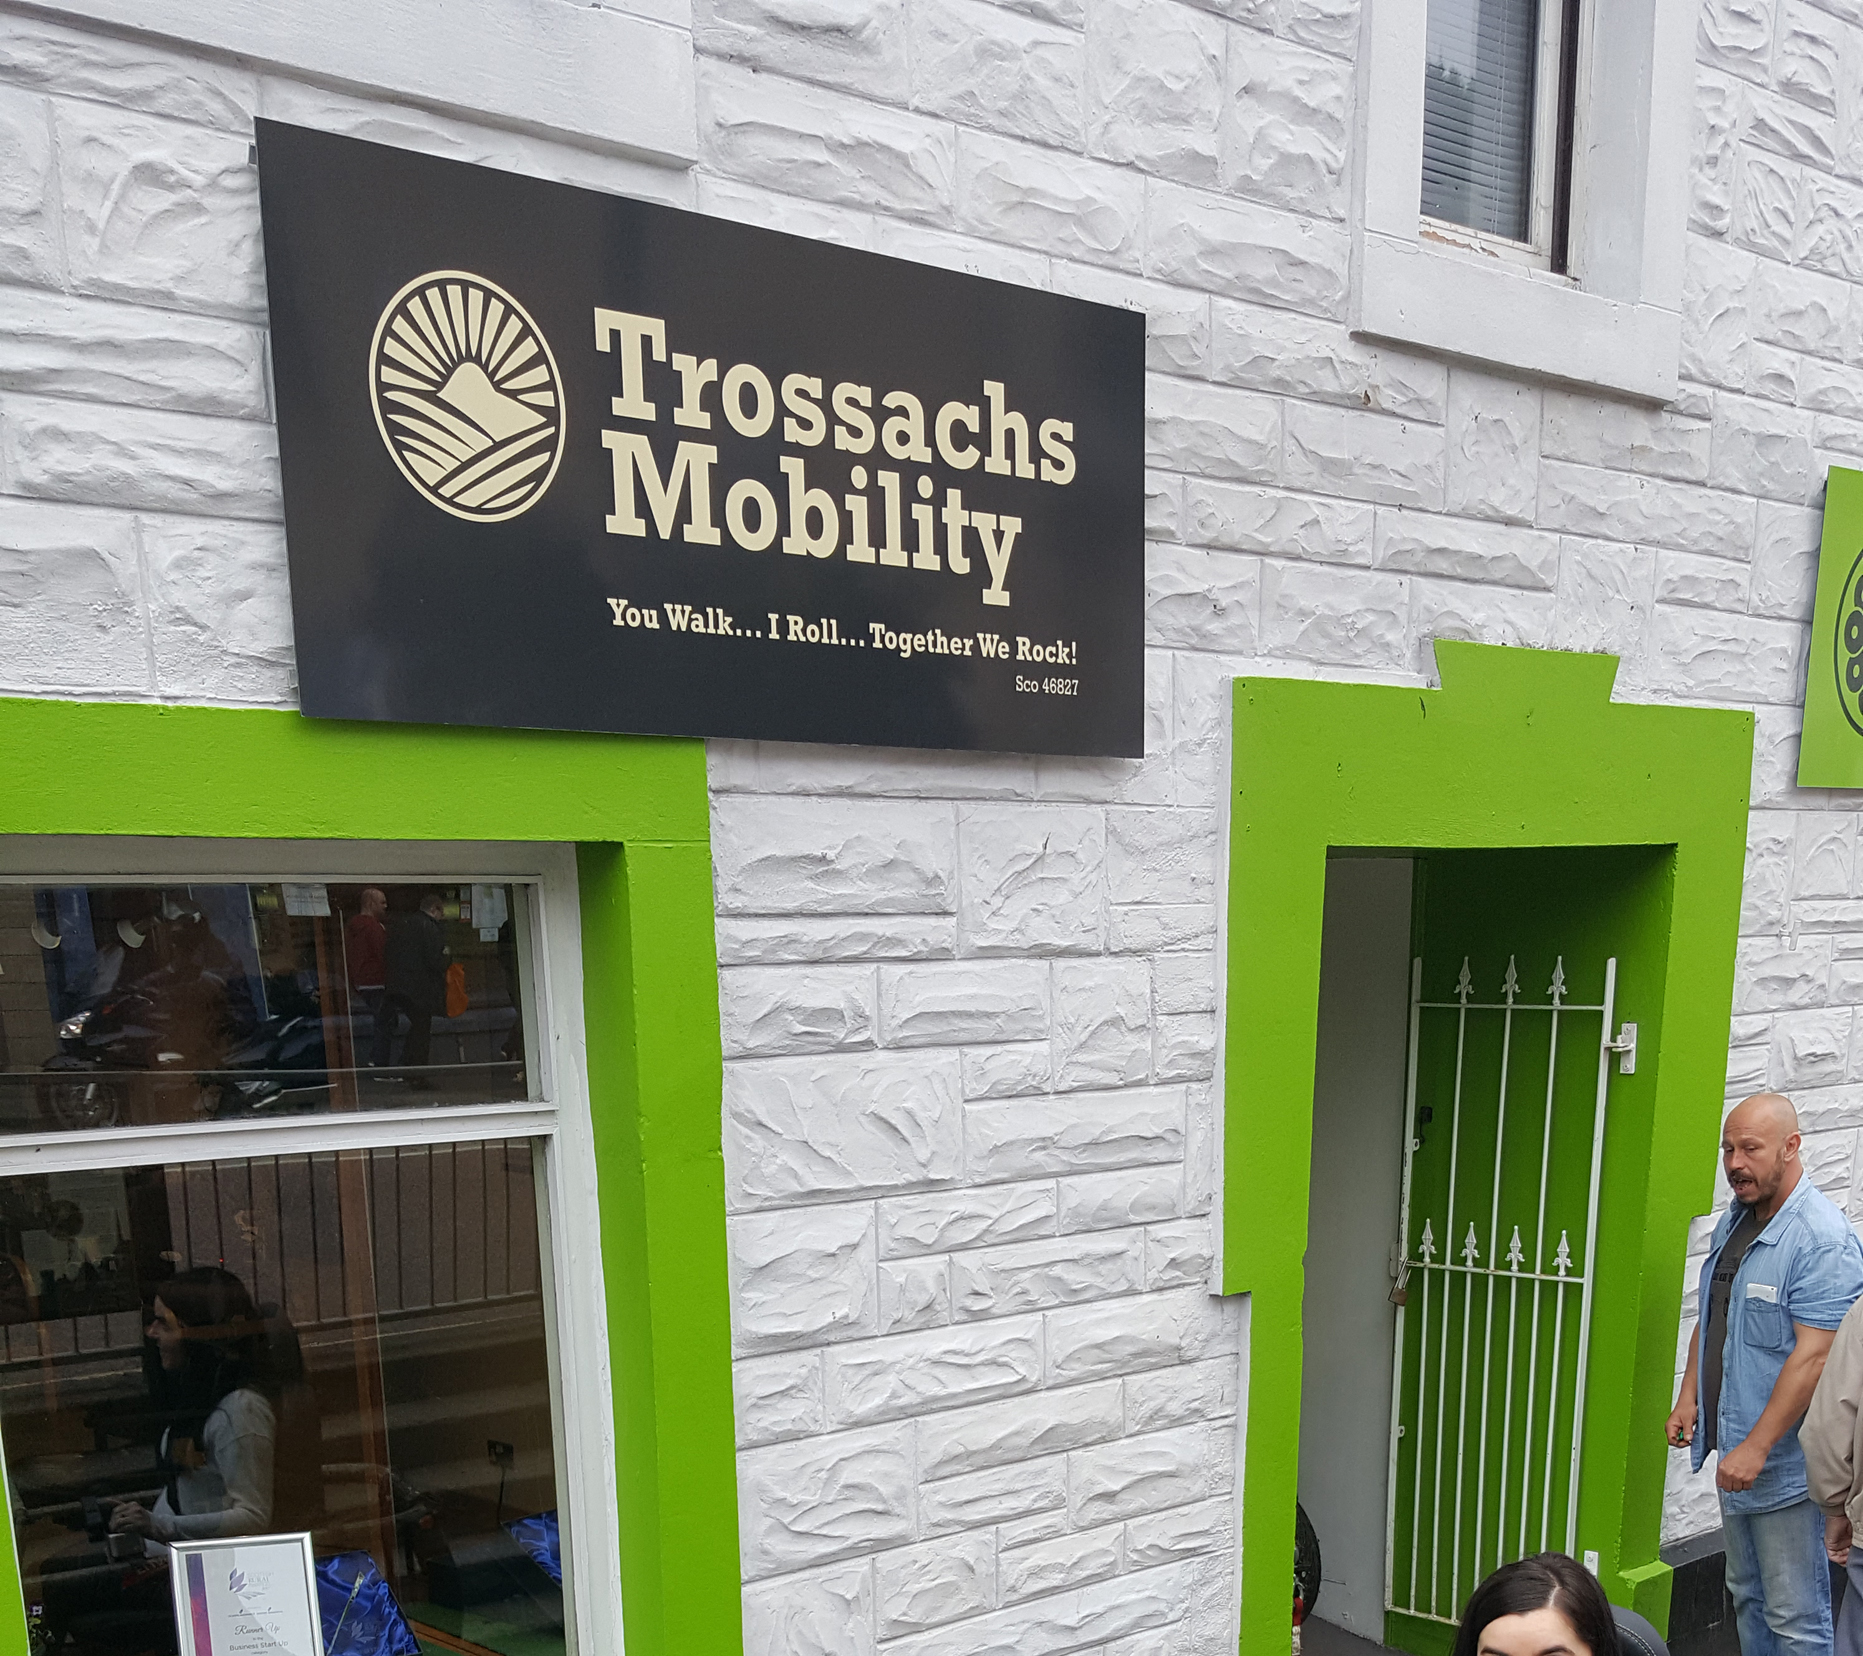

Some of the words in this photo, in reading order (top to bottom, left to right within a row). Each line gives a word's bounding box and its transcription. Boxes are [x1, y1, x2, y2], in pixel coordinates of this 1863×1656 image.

[593, 306, 1077, 486] Trossachs
[601, 428, 1023, 608] Mobility
[606, 597, 660, 630] You
[663, 603, 762, 638] Walk...
[767, 612, 780, 640] I
[786, 614, 865, 647] Roll...
[868, 622, 974, 658] Together
[976, 632, 1010, 660] We
[1015, 636, 1077, 665] Rock!
[1015, 674, 1039, 693] Sco
[1041, 677, 1079, 696] 46827
[234, 1625, 264, 1635] Runner
[265, 1622, 280, 1634] Up
